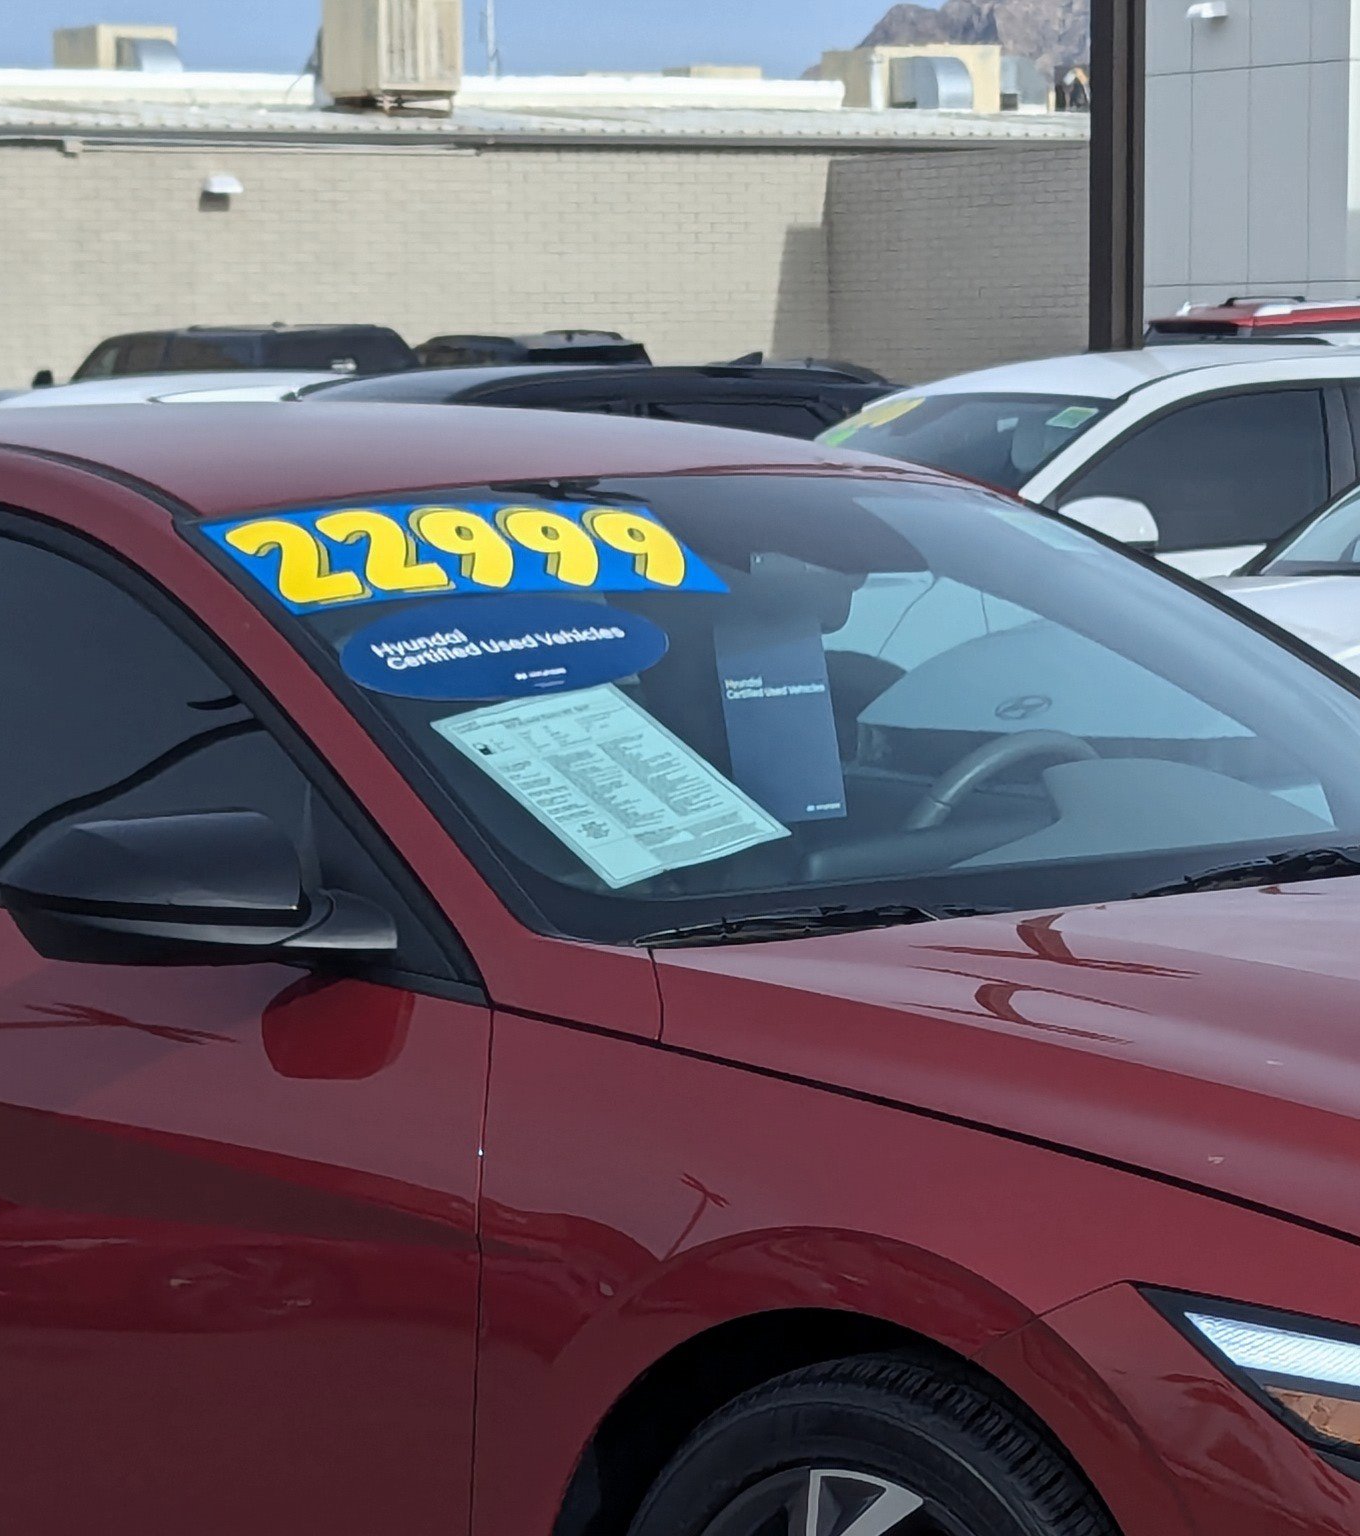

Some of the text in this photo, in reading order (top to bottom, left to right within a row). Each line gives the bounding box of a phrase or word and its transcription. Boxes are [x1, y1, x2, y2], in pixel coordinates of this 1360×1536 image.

[225, 505, 686, 605] 22999
[370, 628, 468, 658] Hyundai
[387, 627, 626, 670] Certified Used Vehicles
